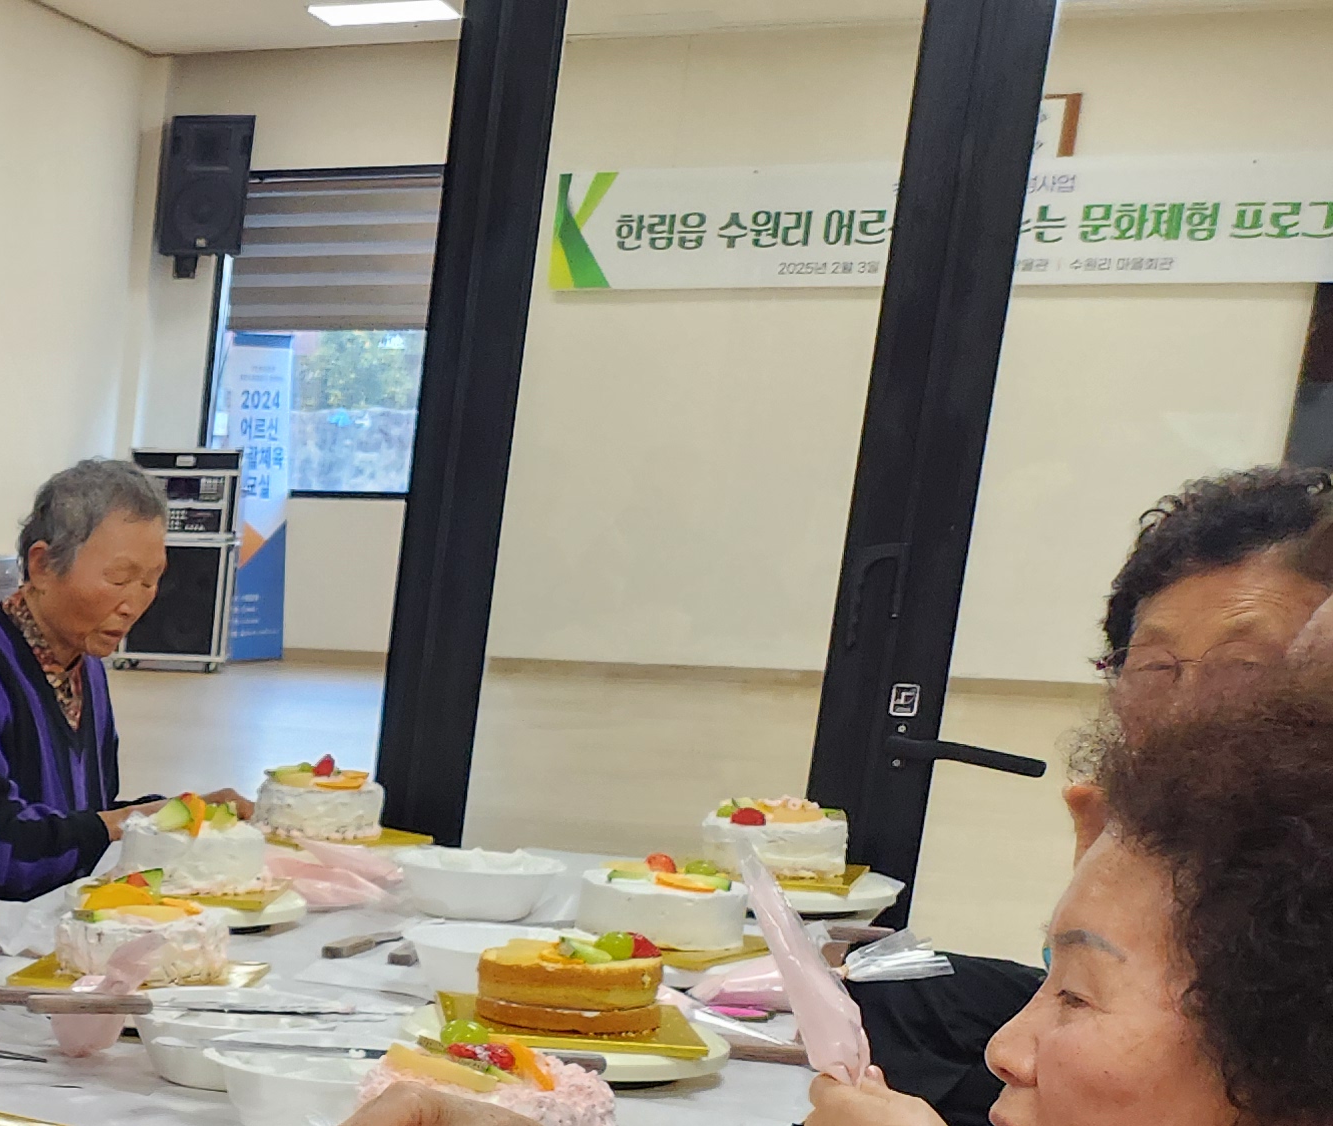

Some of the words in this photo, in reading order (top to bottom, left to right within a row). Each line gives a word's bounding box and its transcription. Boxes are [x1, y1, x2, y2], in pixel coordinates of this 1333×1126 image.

[615, 212, 707, 251] 한림읍
[717, 210, 813, 249] 수원리
[823, 208, 892, 247] 어르
[1078, 202, 1221, 242] 문화체험
[777, 261, 827, 275] 2025년
[1069, 257, 1112, 272] 수원리
[240, 390, 281, 410] 2024
[240, 417, 279, 441] 어르신
[244, 446, 284, 470] 활체육
